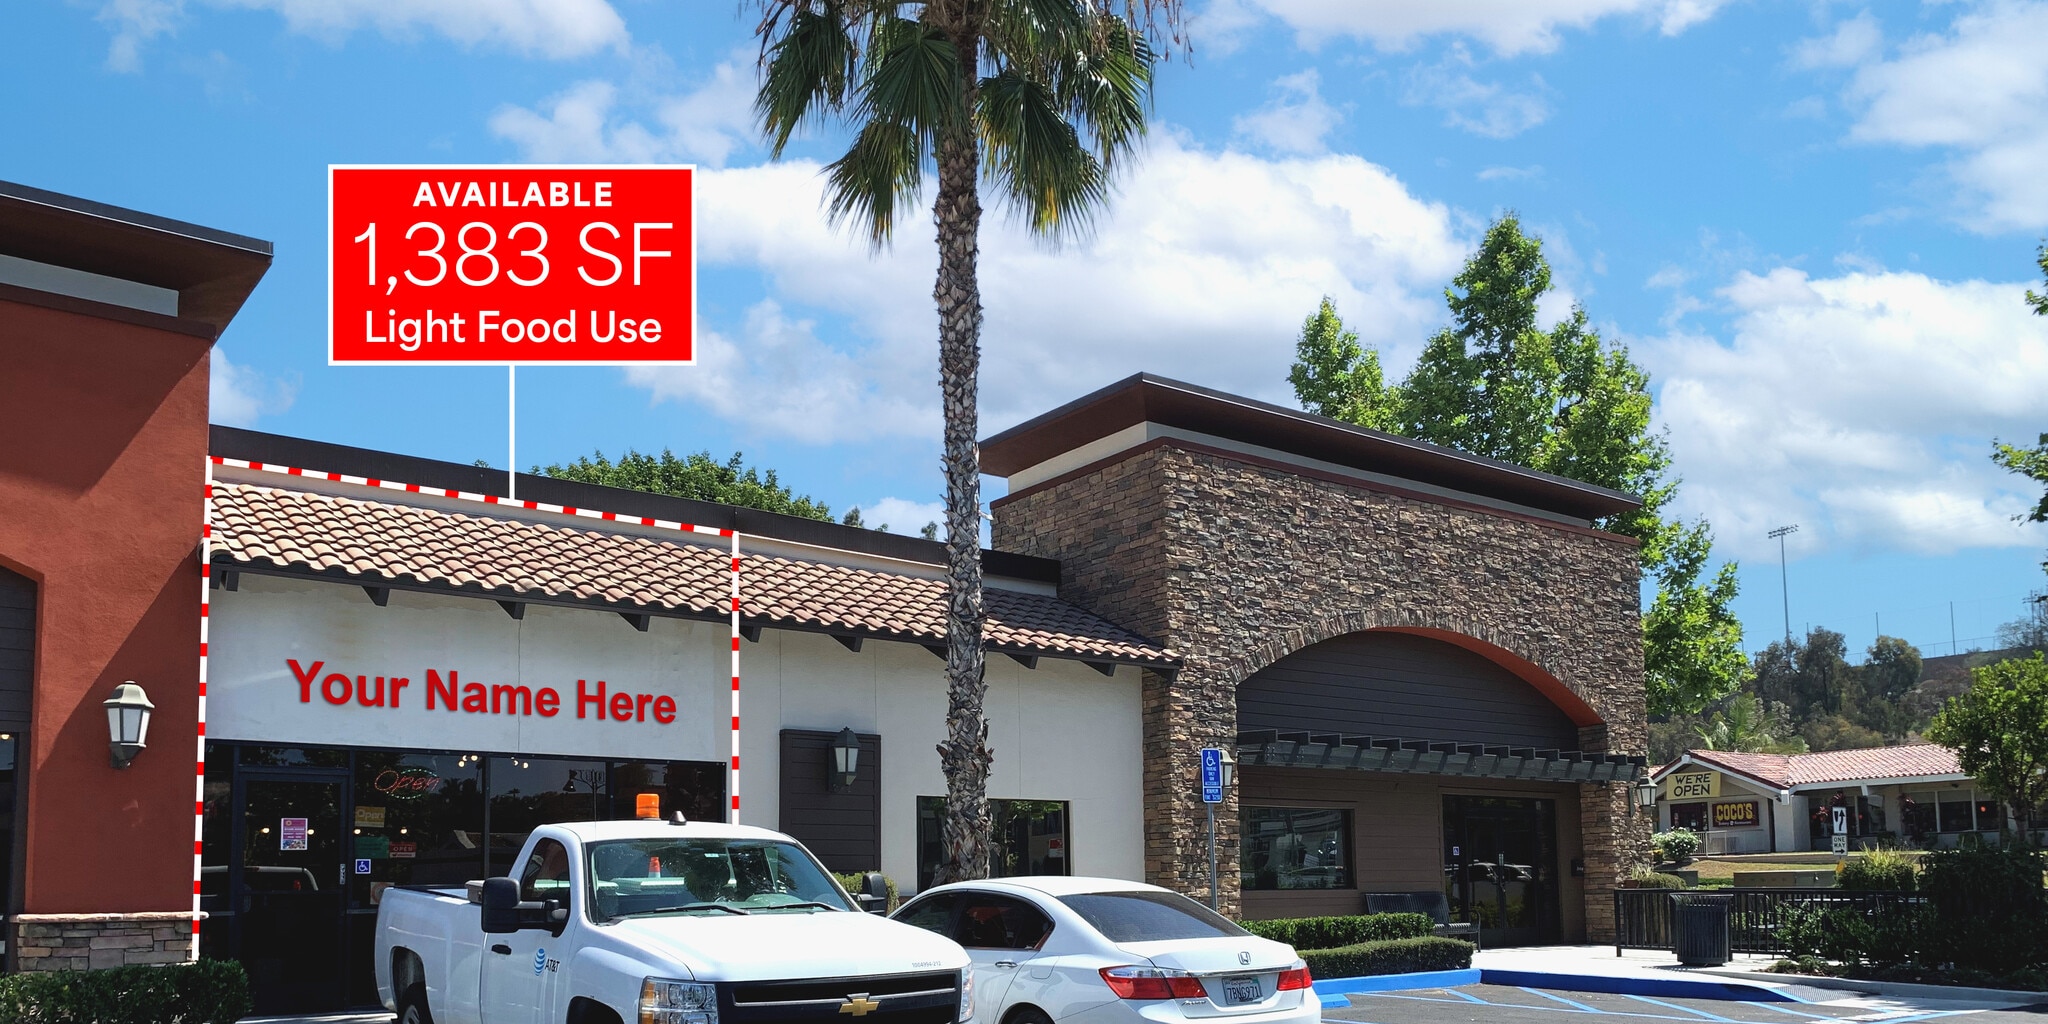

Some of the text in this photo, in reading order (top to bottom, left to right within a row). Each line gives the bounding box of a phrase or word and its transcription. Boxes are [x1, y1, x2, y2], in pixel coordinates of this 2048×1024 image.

[374, 770, 440, 794] Open
[1675, 773, 1711, 784] WE'RE
[1673, 784, 1710, 797] OPEN
[356, 809, 384, 821] Open
[1716, 803, 1753, 821] COCO'S
[544, 958, 560, 972] AT&T
